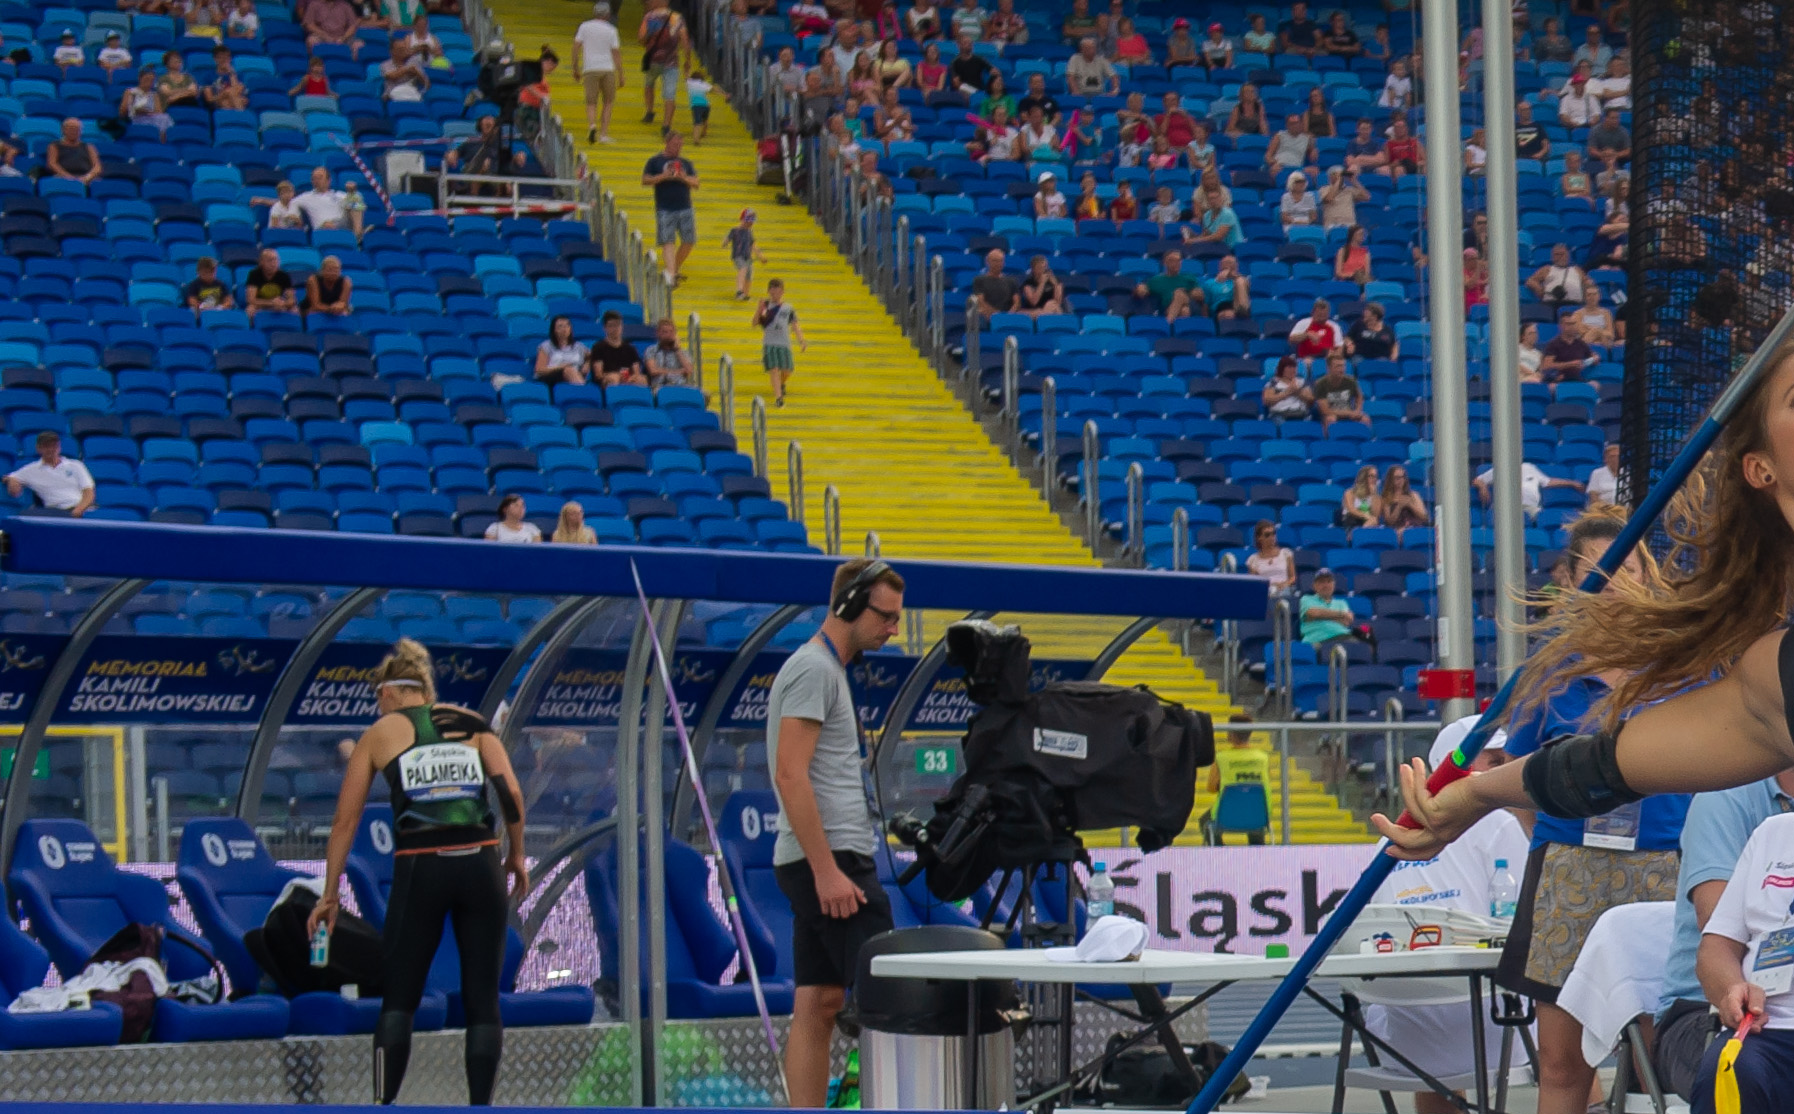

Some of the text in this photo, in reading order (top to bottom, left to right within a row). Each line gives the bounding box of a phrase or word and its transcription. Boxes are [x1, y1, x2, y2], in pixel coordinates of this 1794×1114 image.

[86, 660, 208, 677] MEMORIAŁ
[315, 666, 377, 682] MEMO
[77, 676, 162, 693] KAMILI
[305, 681, 378, 699] KAMIL
[545, 685, 617, 700] KAMILI
[68, 693, 256, 713] SKOLIMOWSKIEJ
[924, 749, 948, 773] 33
[406, 762, 480, 786] PALAMEIKA
